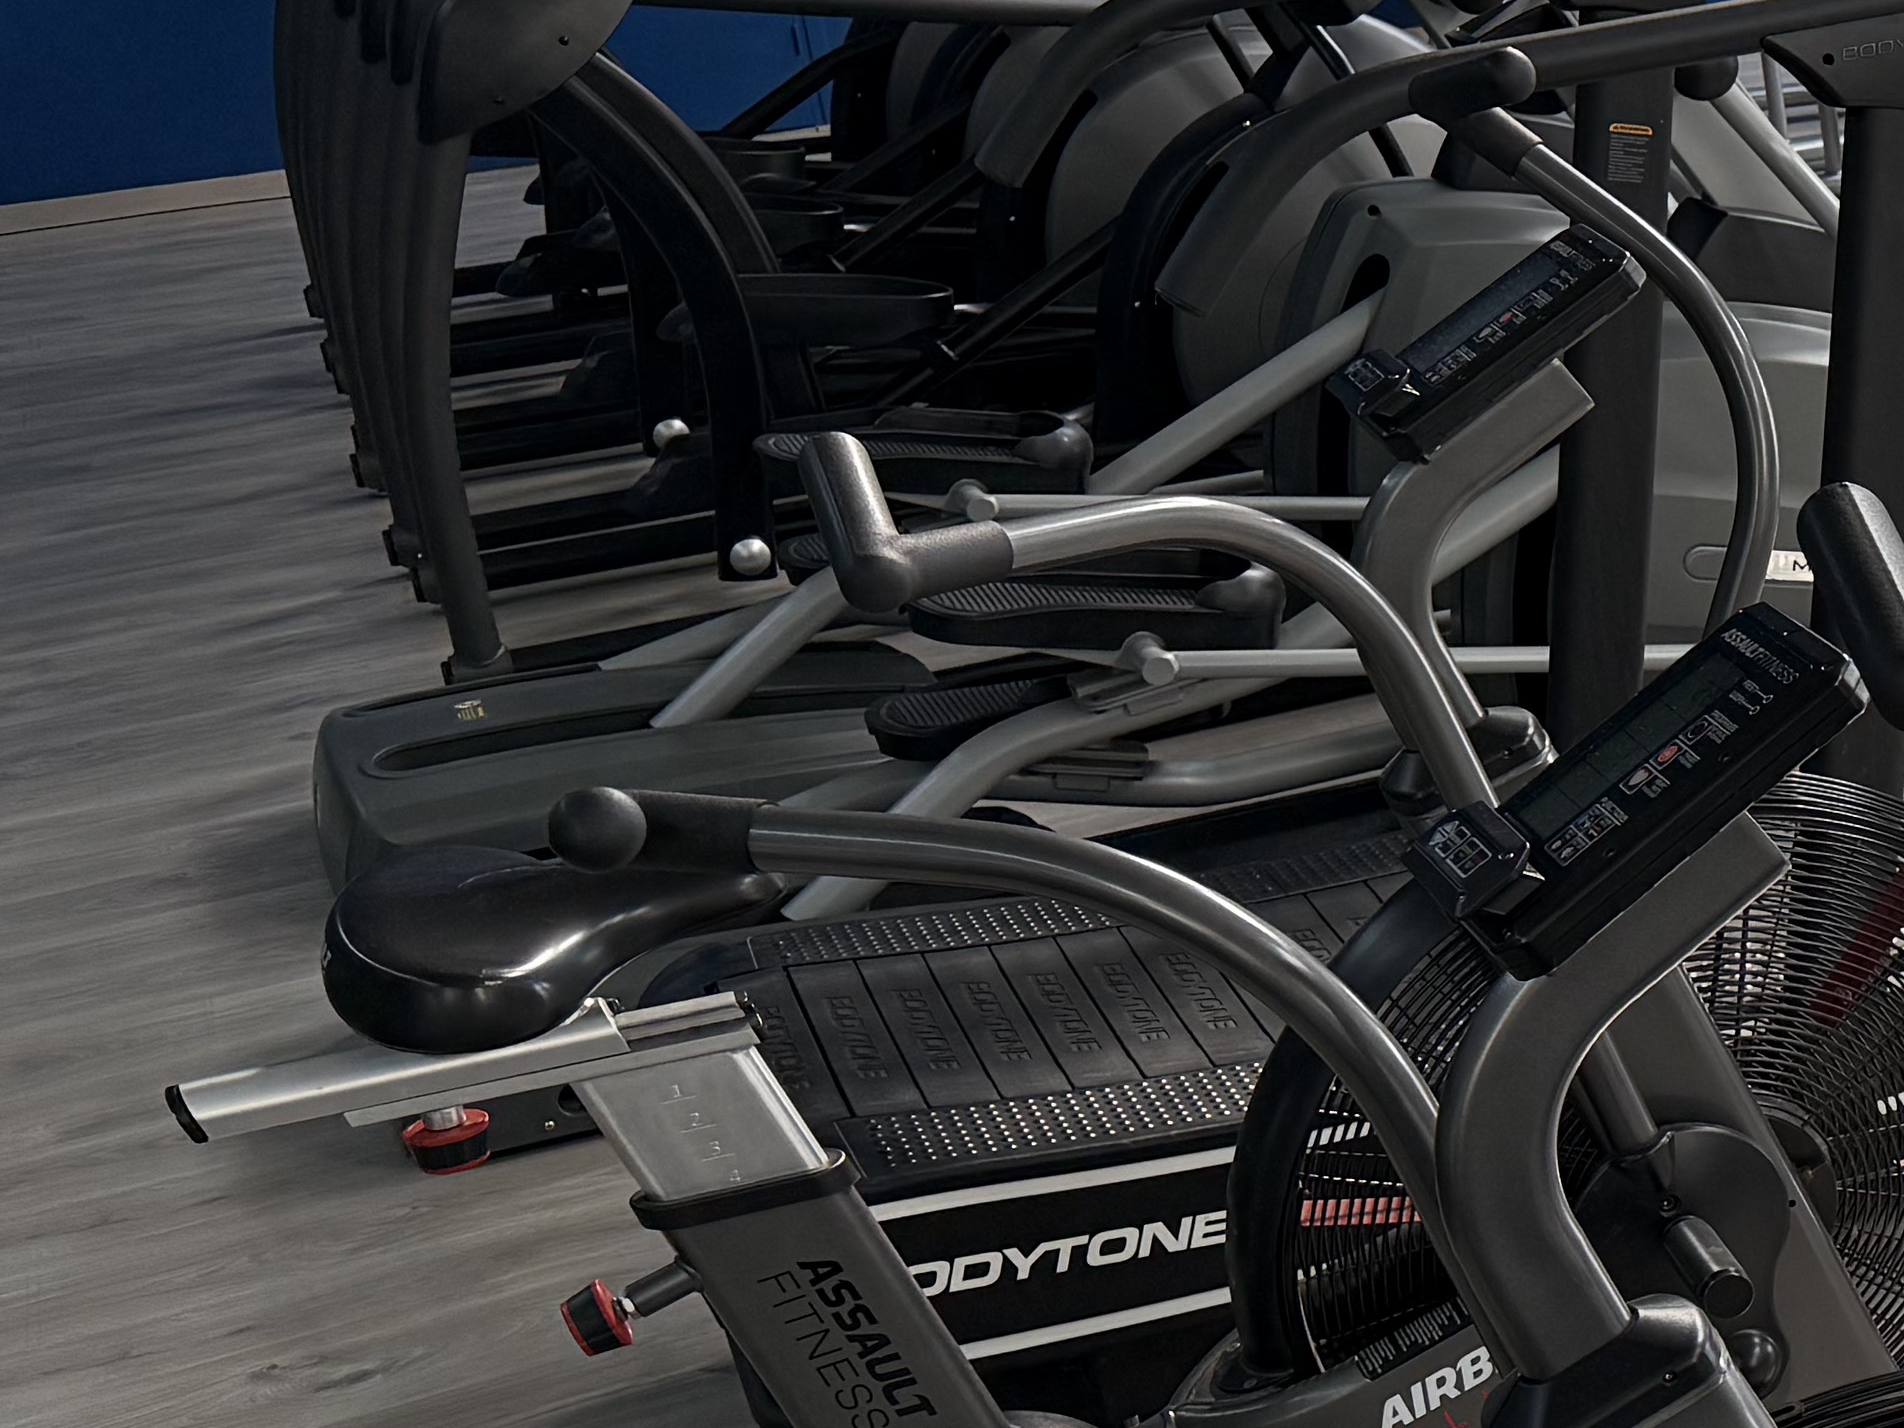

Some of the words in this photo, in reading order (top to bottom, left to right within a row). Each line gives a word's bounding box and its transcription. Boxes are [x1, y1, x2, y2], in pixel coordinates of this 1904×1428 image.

[1027, 971, 1102, 1054] BODYTONE
[906, 1209, 1228, 1299] ODYTONE
[796, 1259, 938, 1419] ASSAULT
